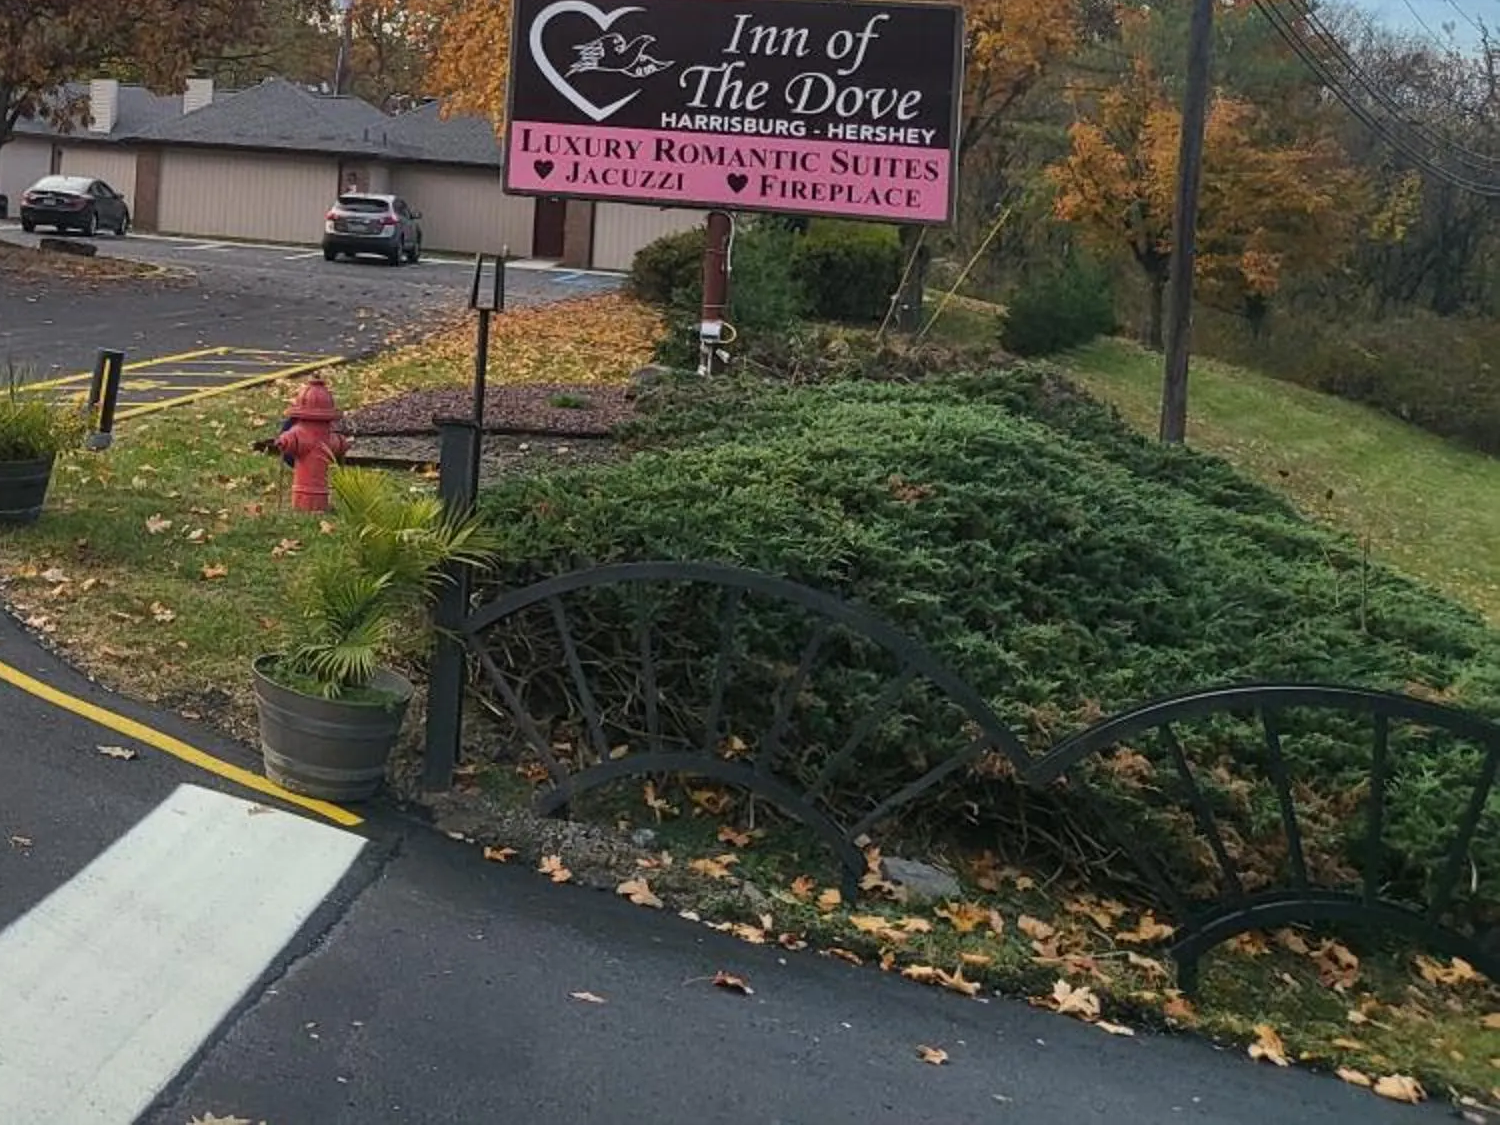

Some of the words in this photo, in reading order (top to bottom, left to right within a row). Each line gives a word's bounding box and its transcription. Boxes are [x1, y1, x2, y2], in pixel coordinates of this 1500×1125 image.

[723, 13, 809, 56] Inn
[826, 13, 891, 75] of
[679, 61, 769, 110] The
[784, 72, 923, 121] Dove
[661, 112, 807, 138] HARRISBURG
[827, 125, 937, 145] HERSHEY
[521, 128, 644, 161] LUXURY
[654, 137, 819, 174] ROMANTIC
[830, 149, 940, 182] SUITES
[565, 161, 685, 192] JACUZZI
[759, 175, 922, 210] FIREPLACE
